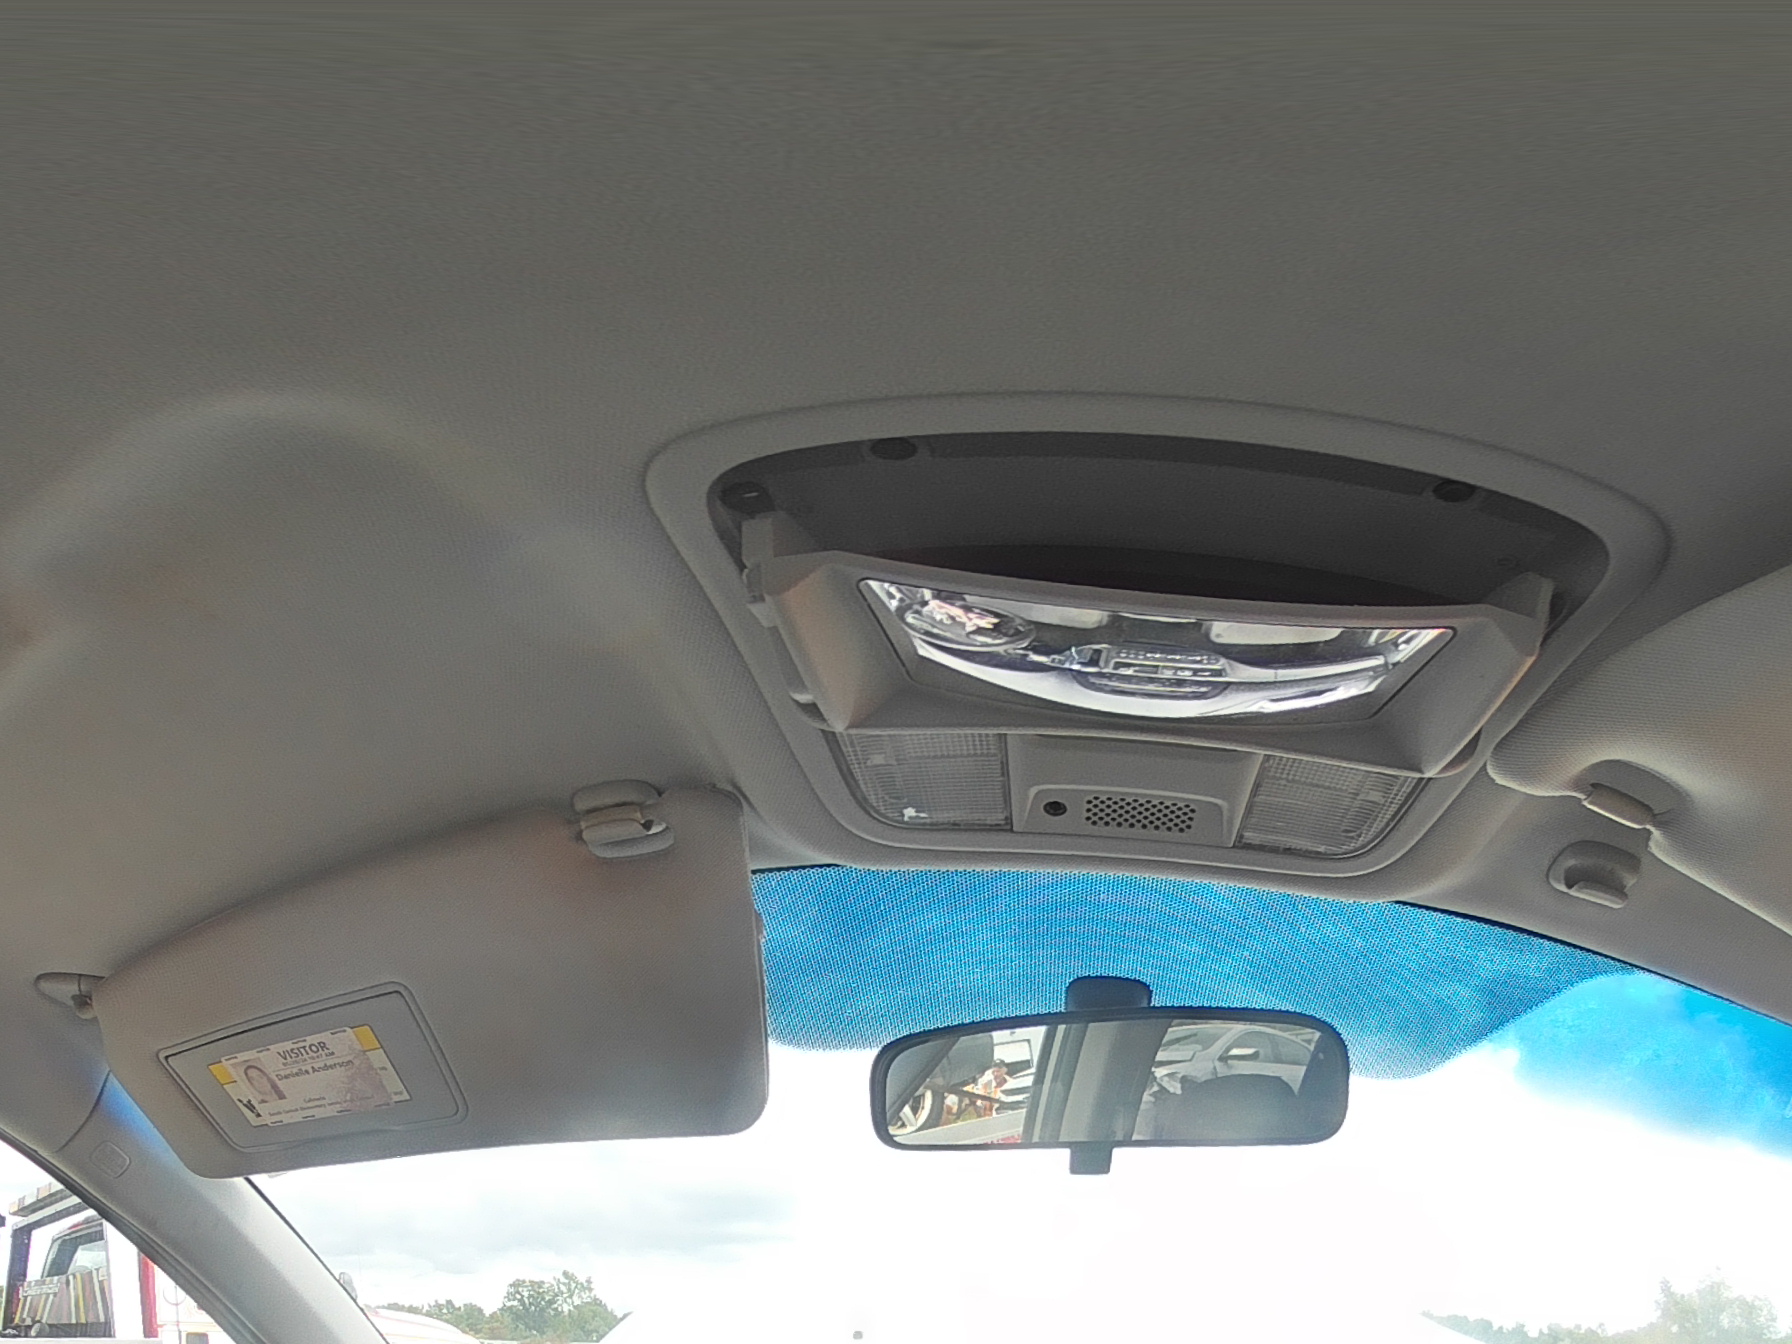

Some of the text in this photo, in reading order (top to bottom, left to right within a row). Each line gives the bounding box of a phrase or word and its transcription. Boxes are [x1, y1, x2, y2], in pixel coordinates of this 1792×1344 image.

[276, 1041, 330, 1061] VISITOR
[275, 1060, 355, 1081] Danielle Anderson
